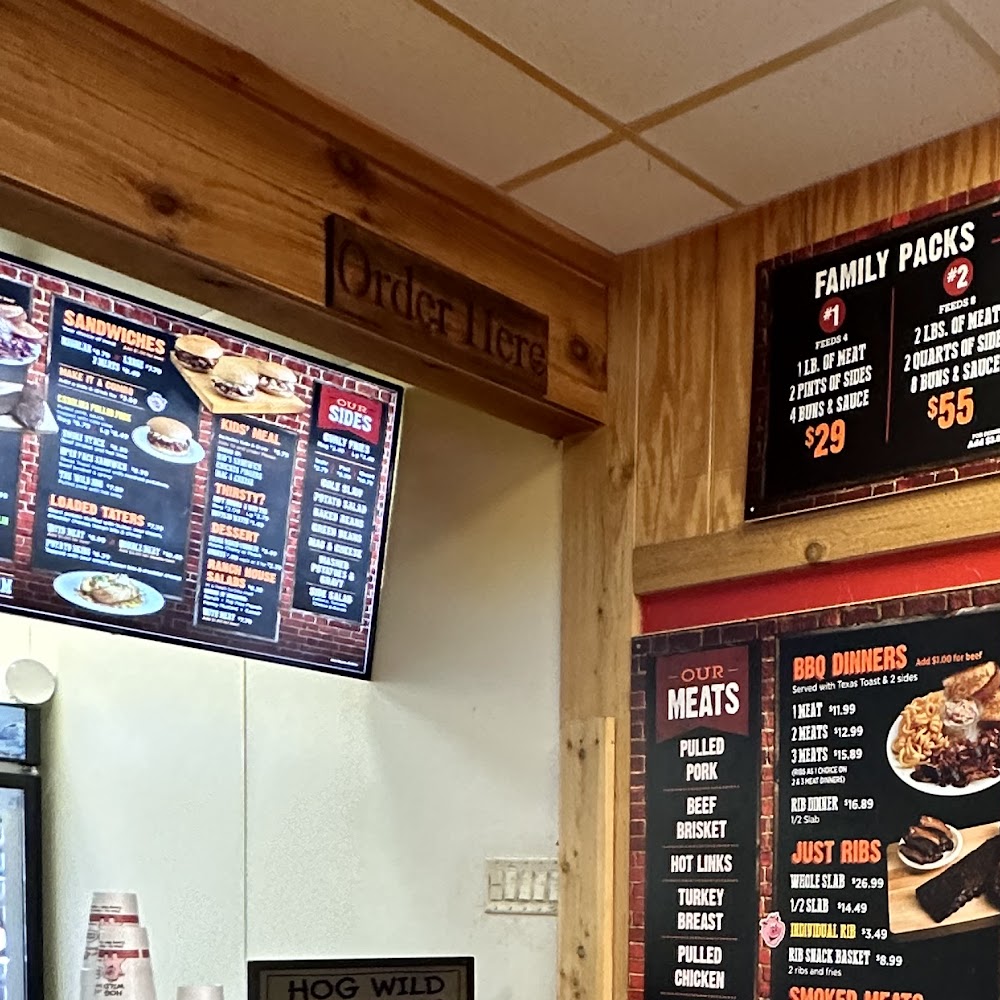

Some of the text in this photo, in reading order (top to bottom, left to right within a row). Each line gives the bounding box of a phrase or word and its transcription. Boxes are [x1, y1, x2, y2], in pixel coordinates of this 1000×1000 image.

[815, 222, 975, 299] FAMILY PACKS
[947, 264, 969, 289] #2
[338, 240, 454, 336] Order
[824, 305, 839, 326] #1
[64, 310, 166, 355] SANDWICHES
[336, 399, 368, 413] OUR
[928, 387, 973, 429] $55
[328, 406, 372, 432] SIDES
[252, 428, 281, 445] MEAL
[805, 419, 845, 458] $29
[214, 483, 266, 505] THIRSTY?
[49, 494, 97, 516] LOADED
[102, 506, 145, 527] TATERS
[211, 522, 260, 542] DESSERT
[681, 665, 723, 682] OUR
[793, 645, 907, 681] BBQ DINNERS
[793, 673, 918, 694] Served with Texas Toast & 2 sides
[668, 682, 739, 721] MEATS
[680, 737, 725, 758] PULLED
[686, 762, 718, 782] PORK
[686, 796, 717, 815] BEEF
[677, 820, 727, 840] BRISKET
[791, 839, 881, 864] JUST RIBS
[671, 854, 732, 873] HOT LINKS
[678, 888, 724, 906] TURKEY
[677, 913, 724, 931] BREAST
[678, 945, 722, 965] PULLED
[371, 976, 445, 997] WILD
[674, 970, 725, 989] CHICKEN
